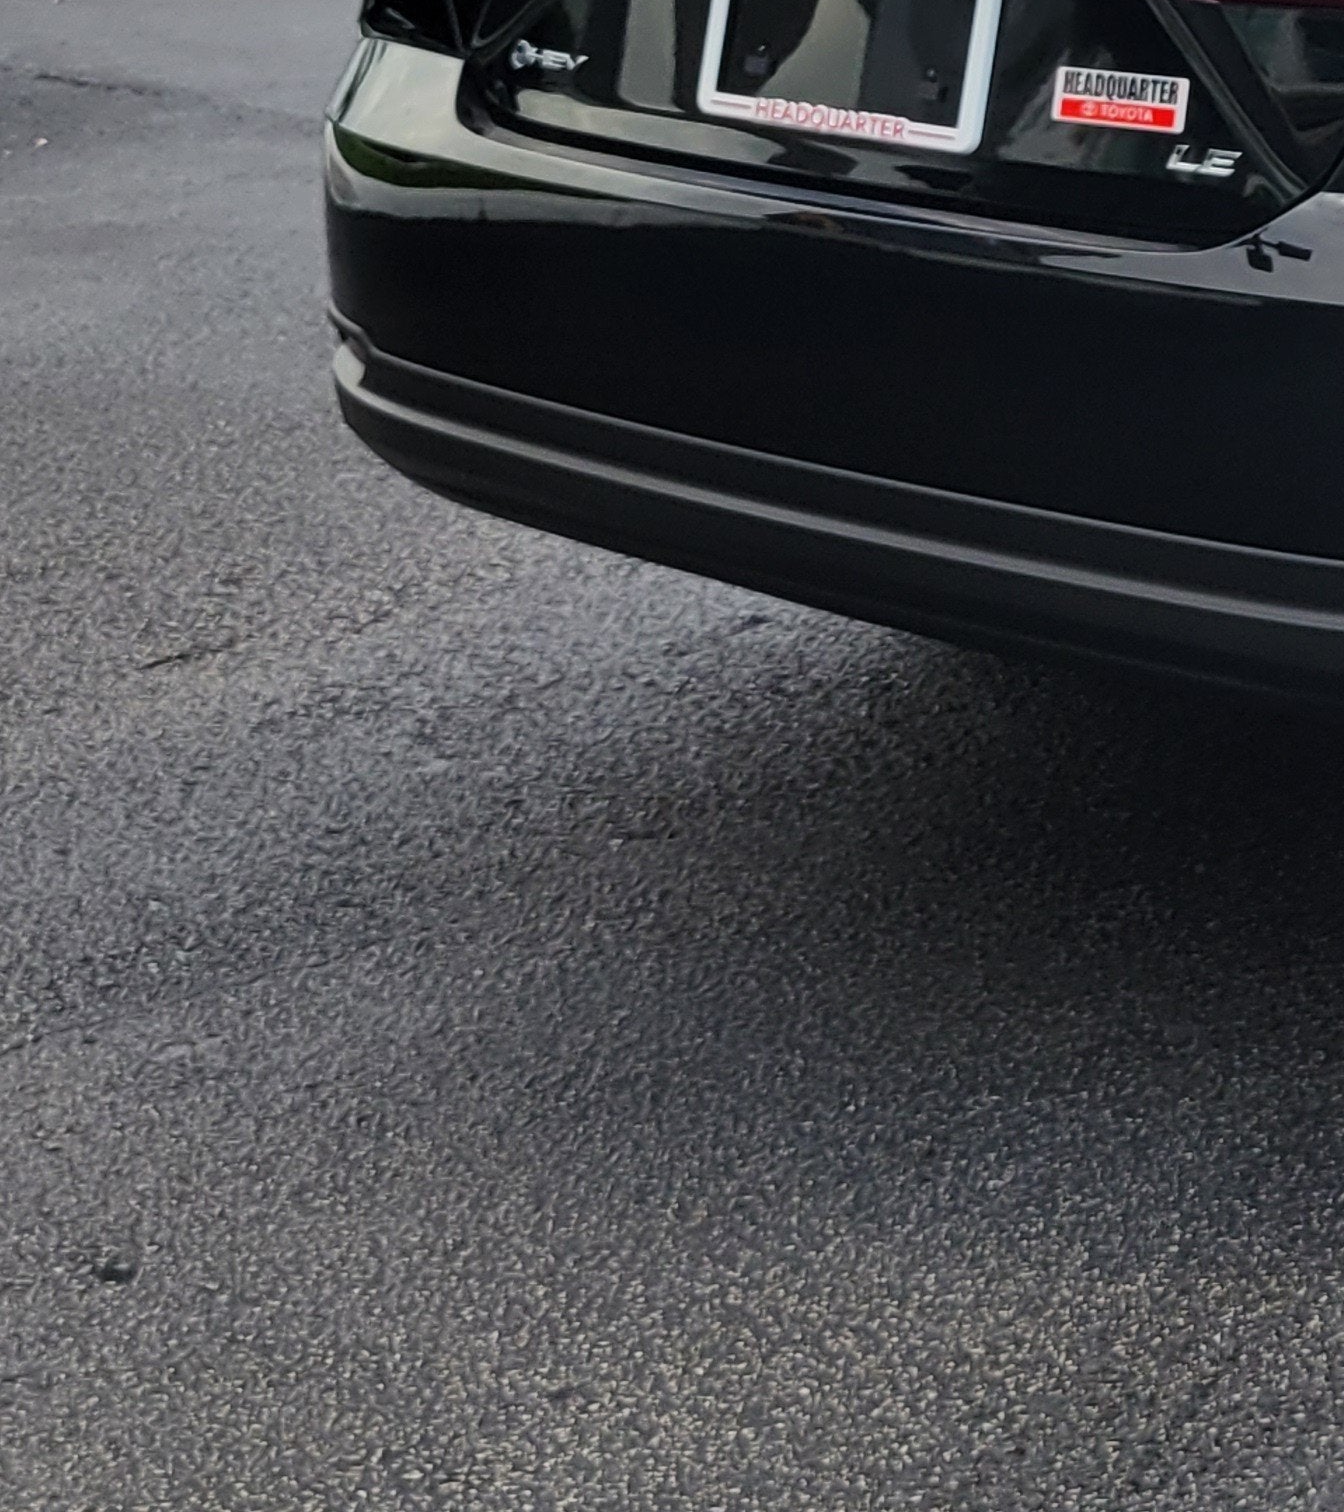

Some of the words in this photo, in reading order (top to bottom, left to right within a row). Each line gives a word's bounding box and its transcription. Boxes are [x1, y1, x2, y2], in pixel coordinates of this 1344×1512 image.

[1062, 69, 1180, 106] HEADQUARTER
[755, 97, 905, 138] HEADQUARTER
[1101, 104, 1154, 123] TOYOTA
[1166, 144, 1243, 177] LE
